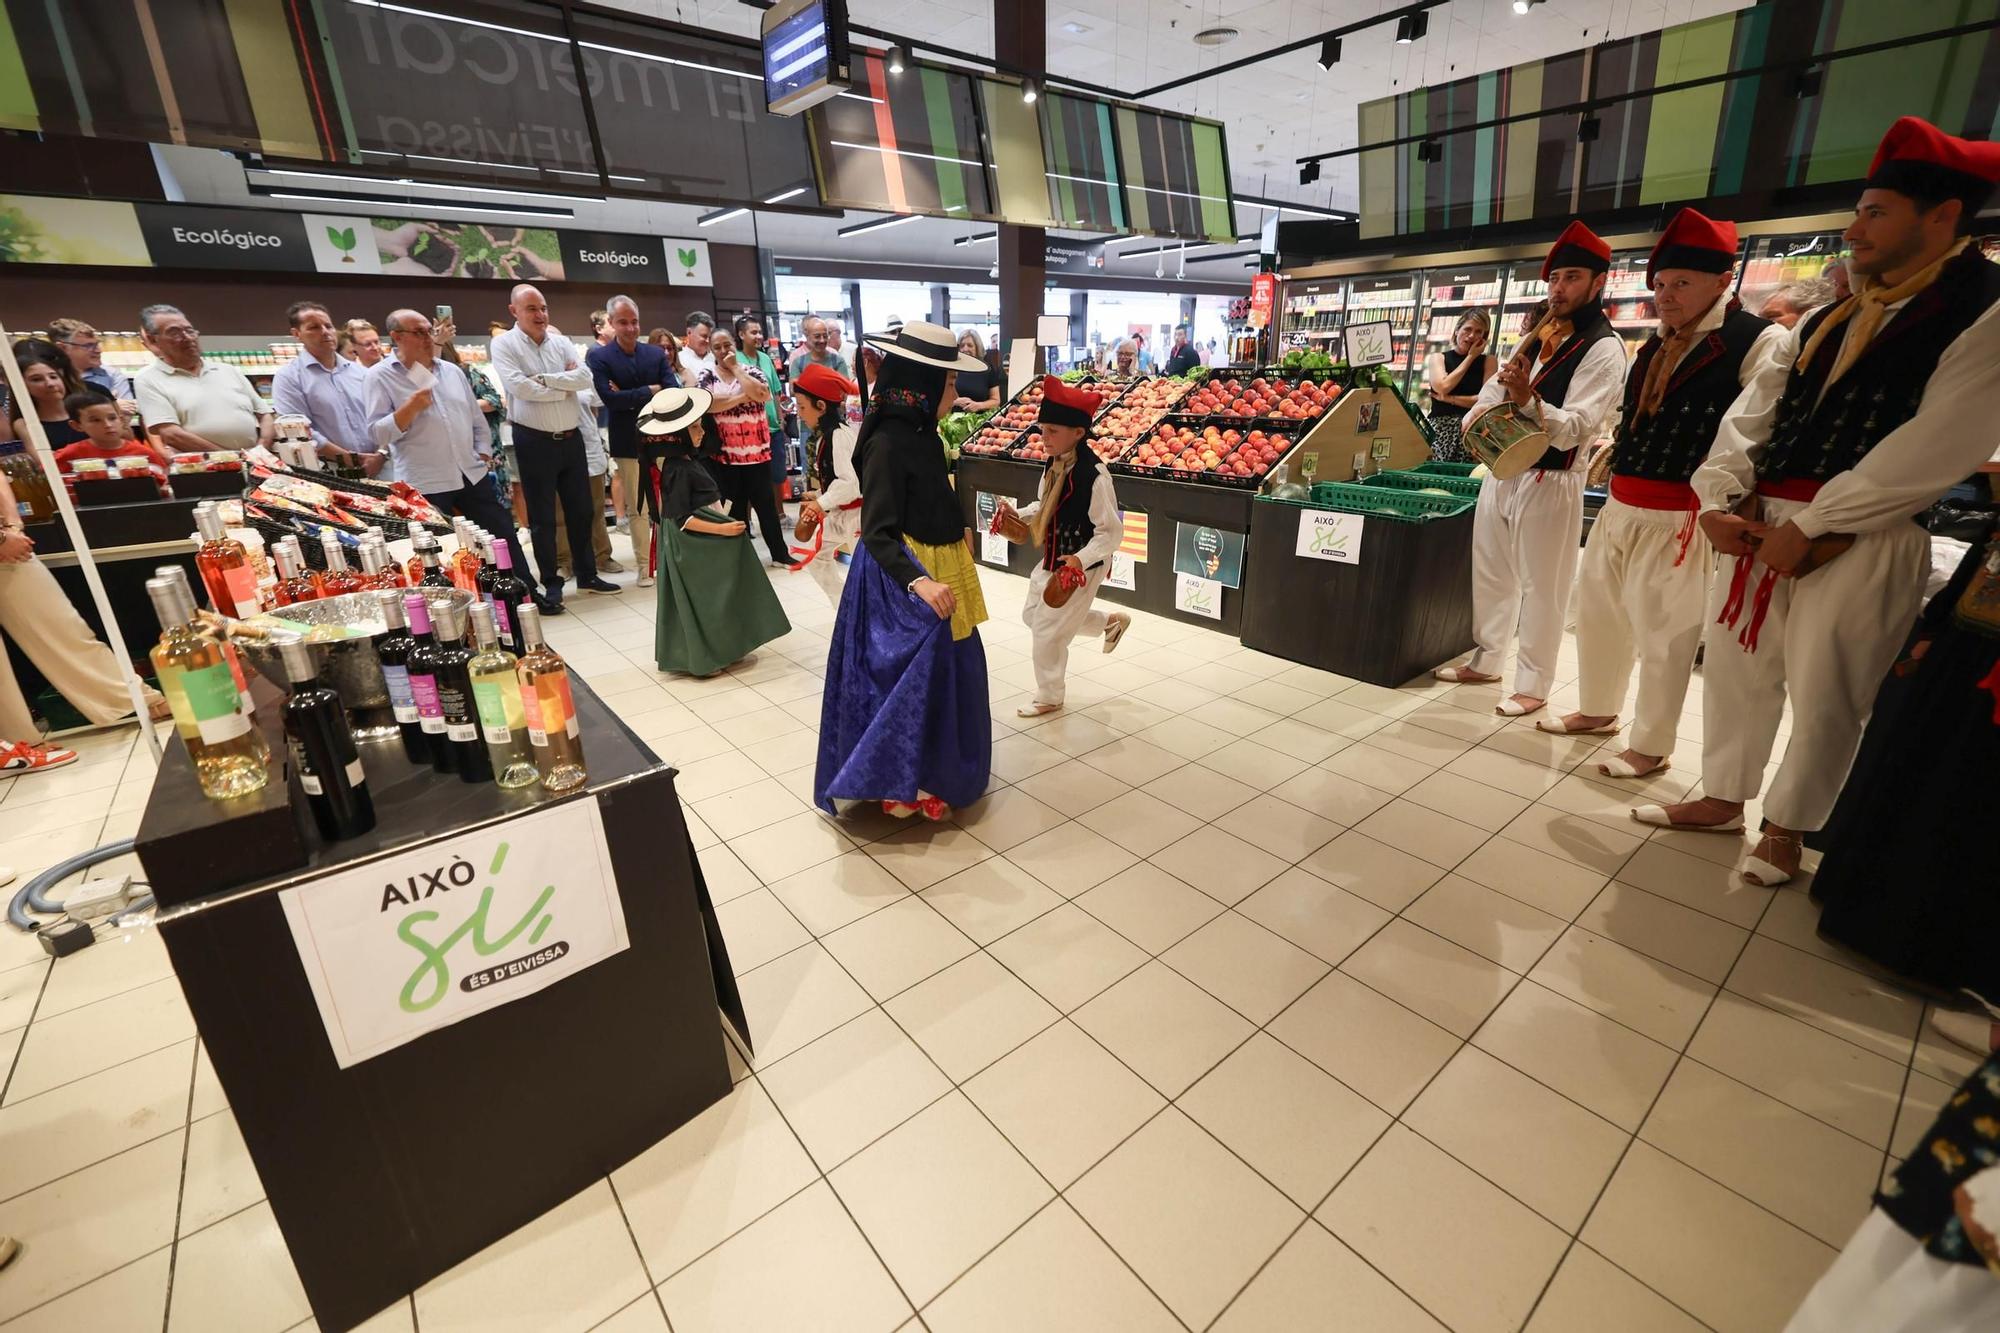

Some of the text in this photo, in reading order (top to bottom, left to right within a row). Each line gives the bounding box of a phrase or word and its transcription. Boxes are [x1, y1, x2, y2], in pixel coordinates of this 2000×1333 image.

[172, 227, 282, 250] Ecológico
[579, 249, 649, 268] Ecológico
[1314, 515, 1335, 526] AIXÒ
[381, 855, 475, 913] AIXÒ
[469, 945, 565, 990] ÉS D'EIVISSA
